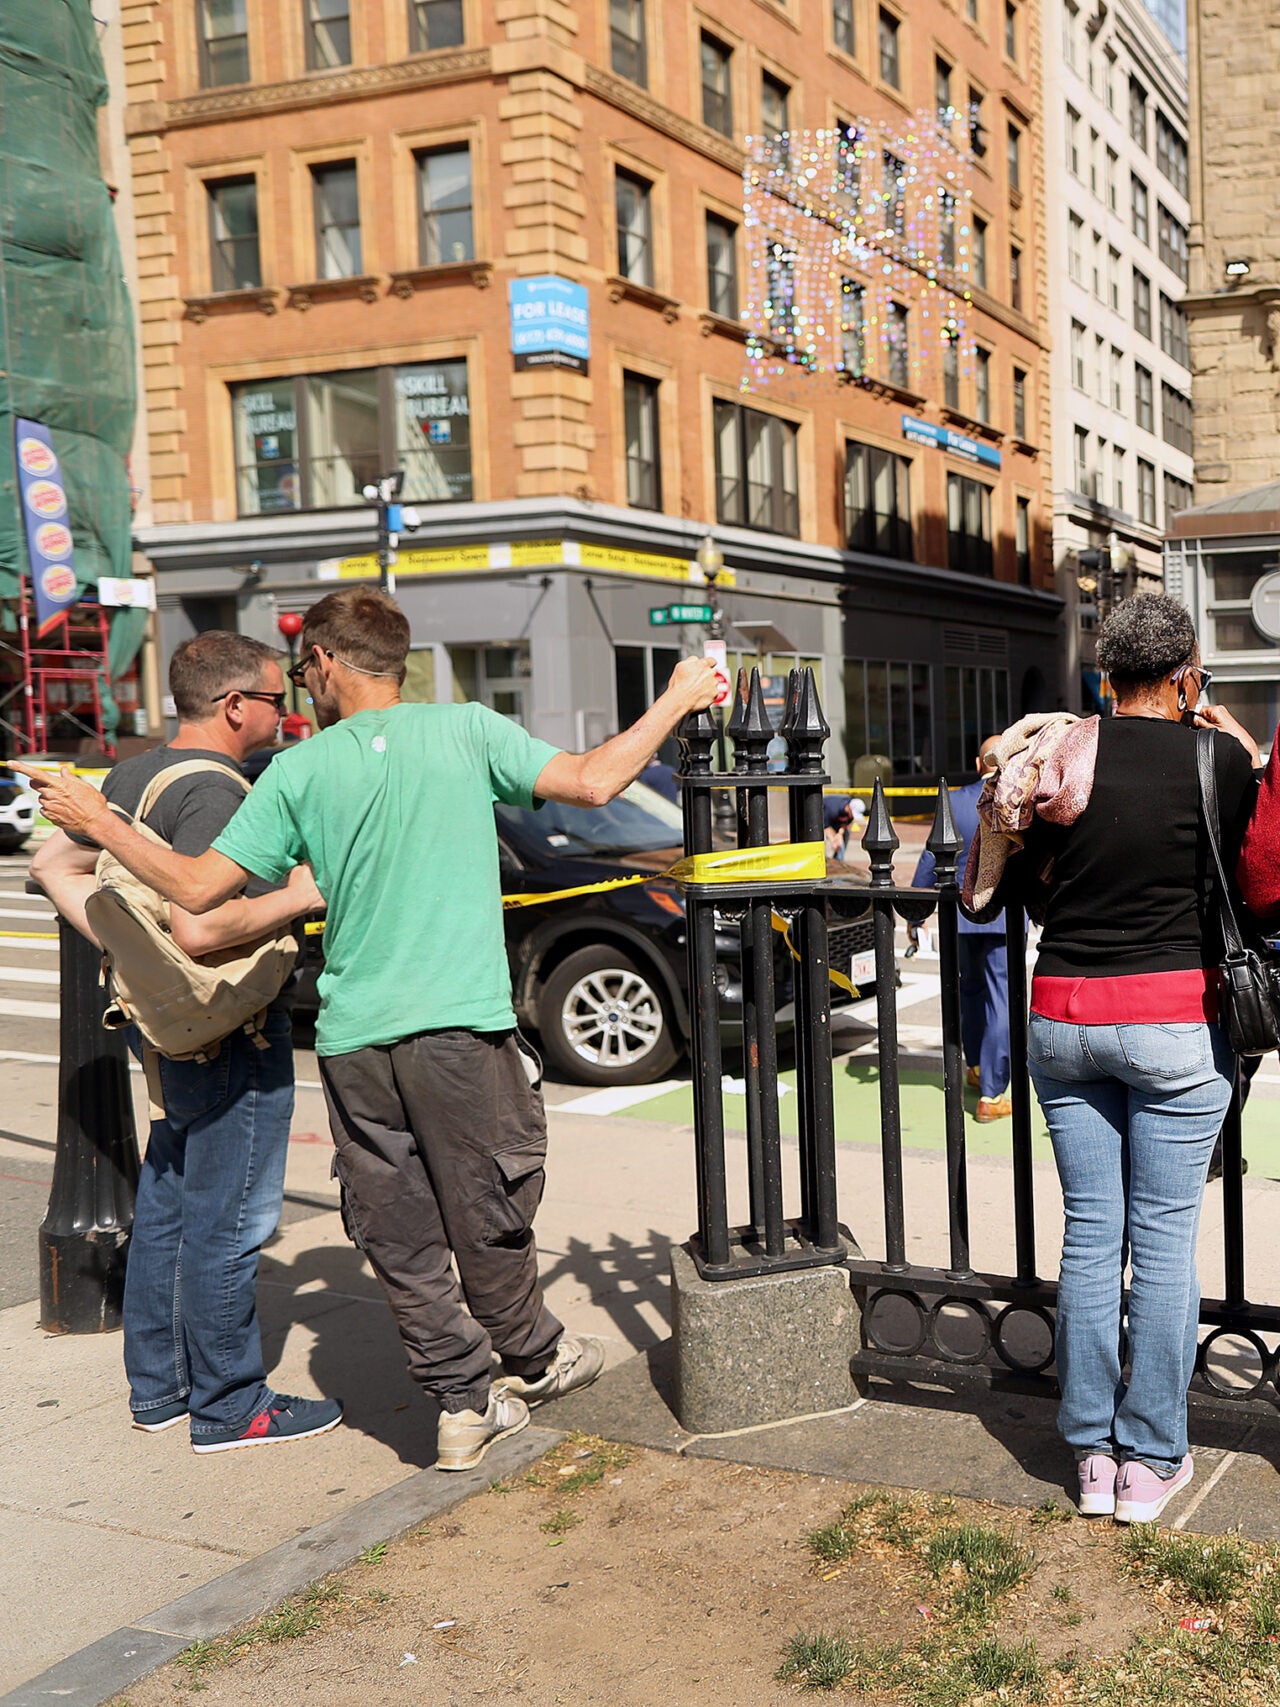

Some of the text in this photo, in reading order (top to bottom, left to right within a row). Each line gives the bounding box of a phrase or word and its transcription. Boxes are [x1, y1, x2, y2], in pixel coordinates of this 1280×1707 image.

[513, 300, 588, 325] FOR LEASE
[405, 374, 448, 396] SKILL
